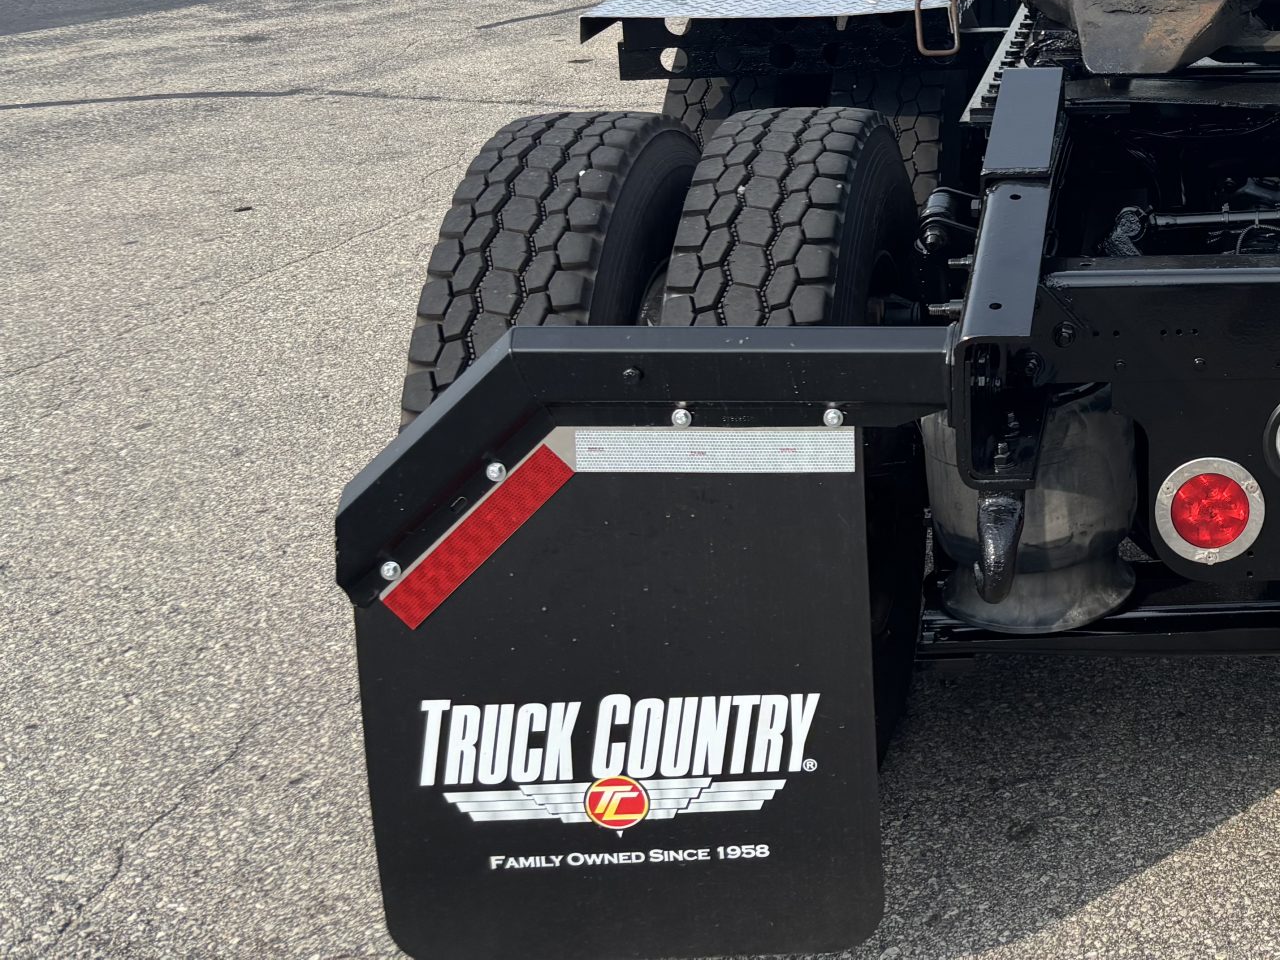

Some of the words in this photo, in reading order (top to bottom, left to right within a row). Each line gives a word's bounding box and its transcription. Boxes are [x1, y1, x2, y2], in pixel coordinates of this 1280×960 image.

[419, 699, 582, 787] TRUCK
[591, 692, 821, 780] COUNTRY
[489, 855, 564, 870] FAMILY
[566, 851, 646, 867] OWNED
[649, 848, 711, 863] SINCE
[716, 844, 770, 860] 1958
